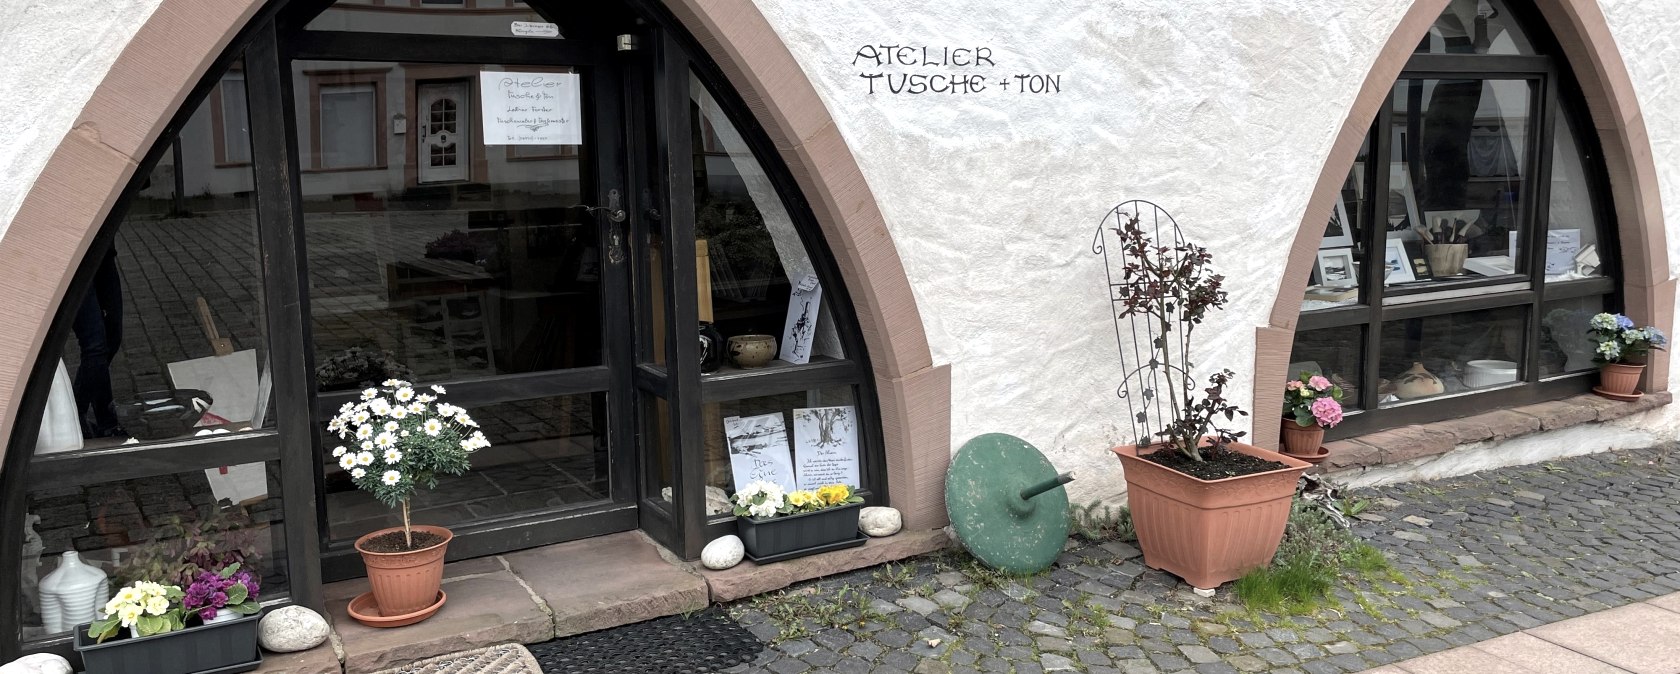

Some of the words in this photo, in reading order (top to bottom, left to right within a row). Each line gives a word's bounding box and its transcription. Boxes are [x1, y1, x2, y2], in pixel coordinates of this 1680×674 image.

[852, 44, 996, 67] ATELIER
[507, 90, 533, 99] Tusche
[859, 72, 987, 95] TUSCHE
[999, 78, 1010, 90] +
[1014, 73, 1061, 94] TON
